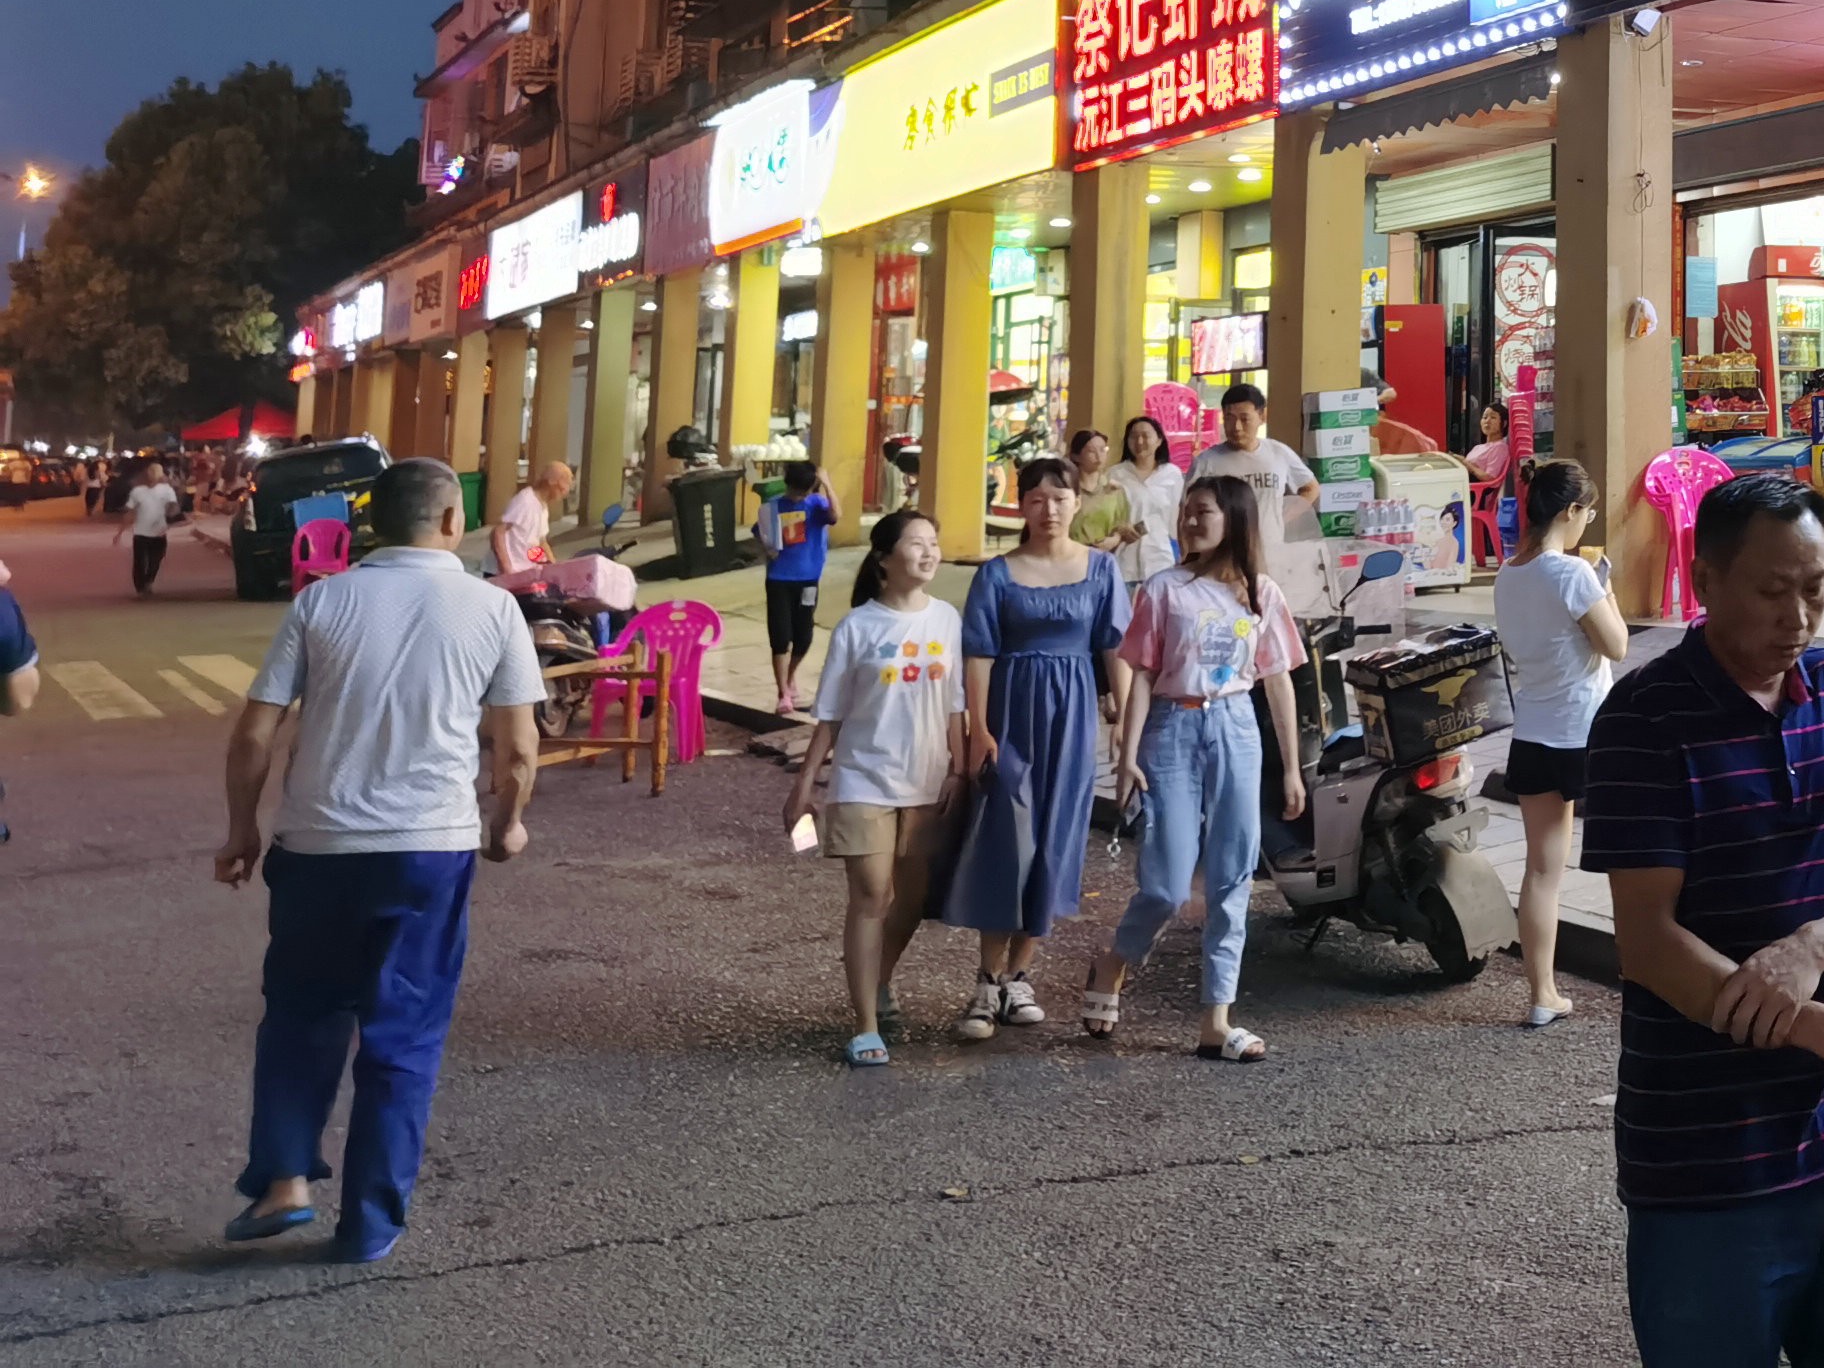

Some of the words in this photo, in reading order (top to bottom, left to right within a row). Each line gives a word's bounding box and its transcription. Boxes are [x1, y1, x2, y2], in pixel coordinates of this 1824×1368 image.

[1073, 29, 1265, 153] 沅江三码头嗦螺
[1424, 701, 1490, 740] 美团外卖
